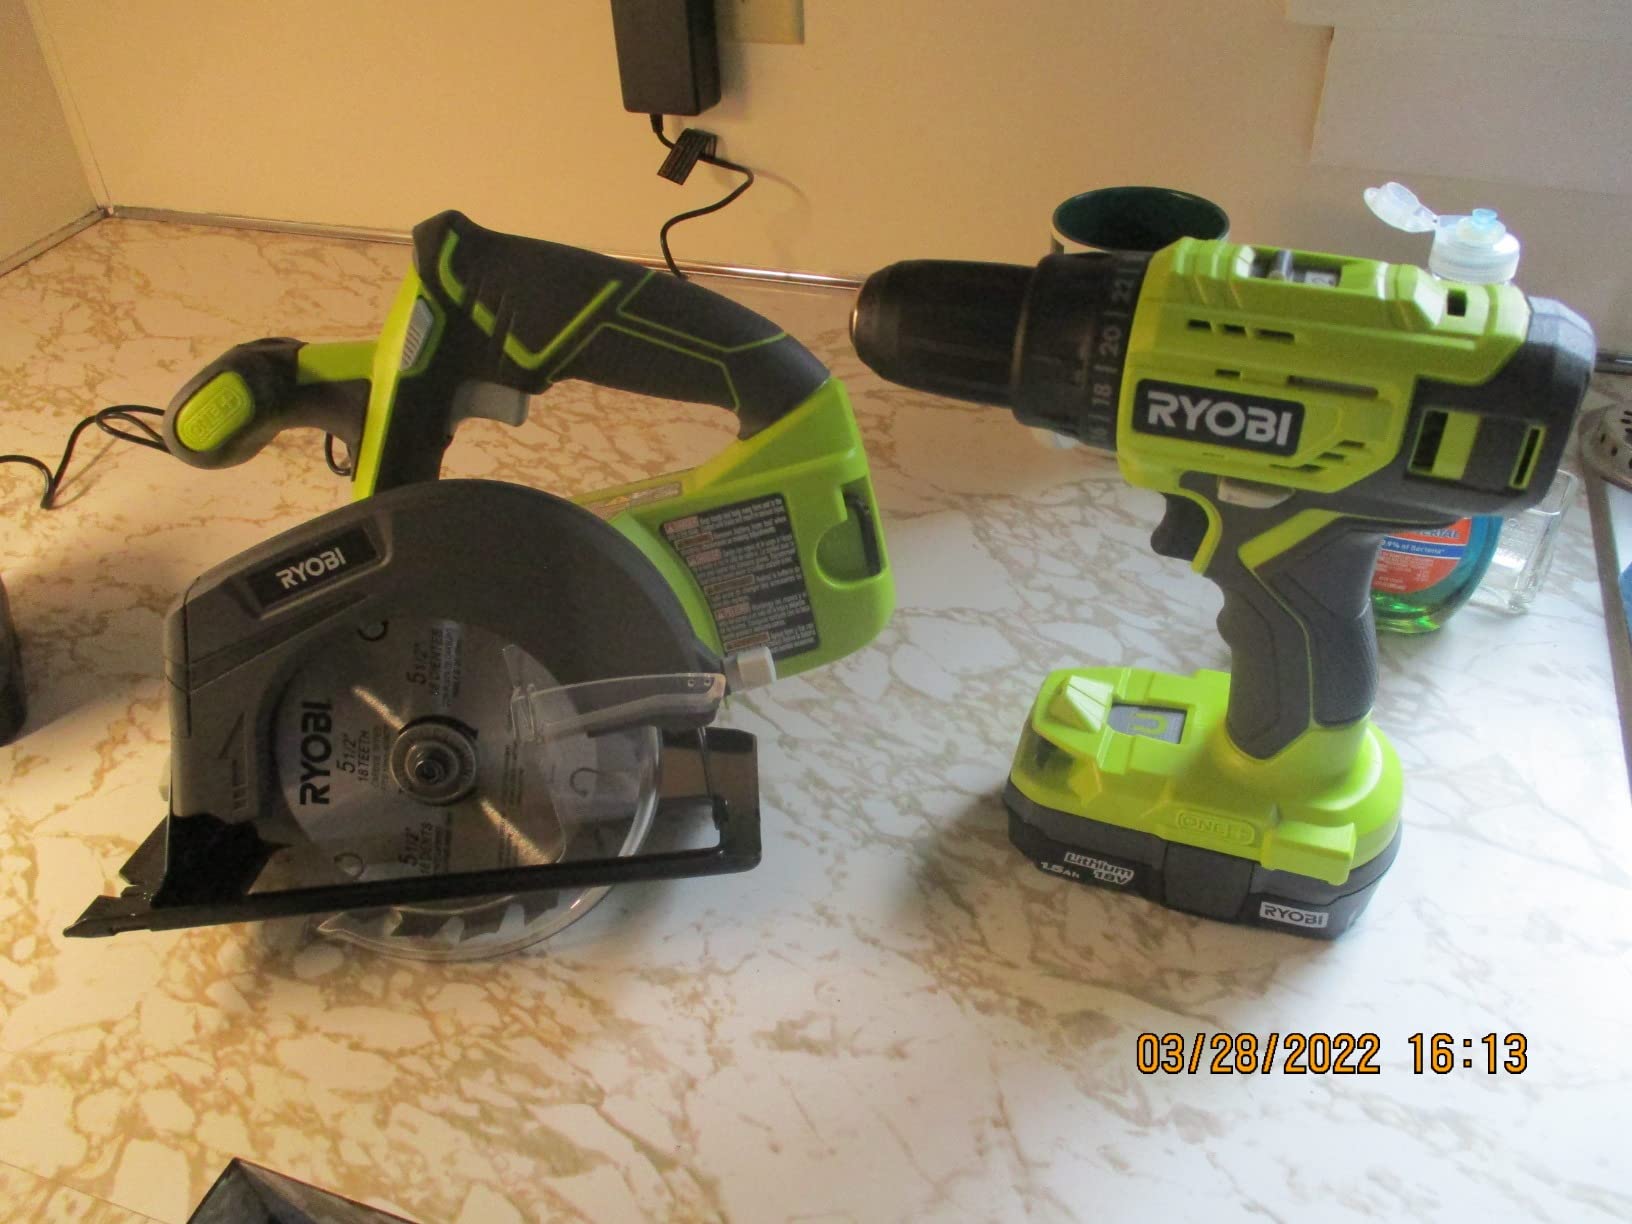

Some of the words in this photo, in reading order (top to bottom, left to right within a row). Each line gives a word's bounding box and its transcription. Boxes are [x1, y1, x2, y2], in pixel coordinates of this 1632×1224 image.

[1101, 324, 1122, 356] 20
[1092, 383, 1113, 406] 18
[1147, 390, 1293, 446] RYOBI
[276, 546, 346, 590] RYOBI
[299, 700, 333, 806] RYOBI
[358, 730, 370, 768] TEETH
[336, 760, 356, 773] 5
[1063, 851, 1135, 878] Lithium
[1093, 868, 1129, 885] 18V
[1264, 904, 1325, 927] RYOBI
